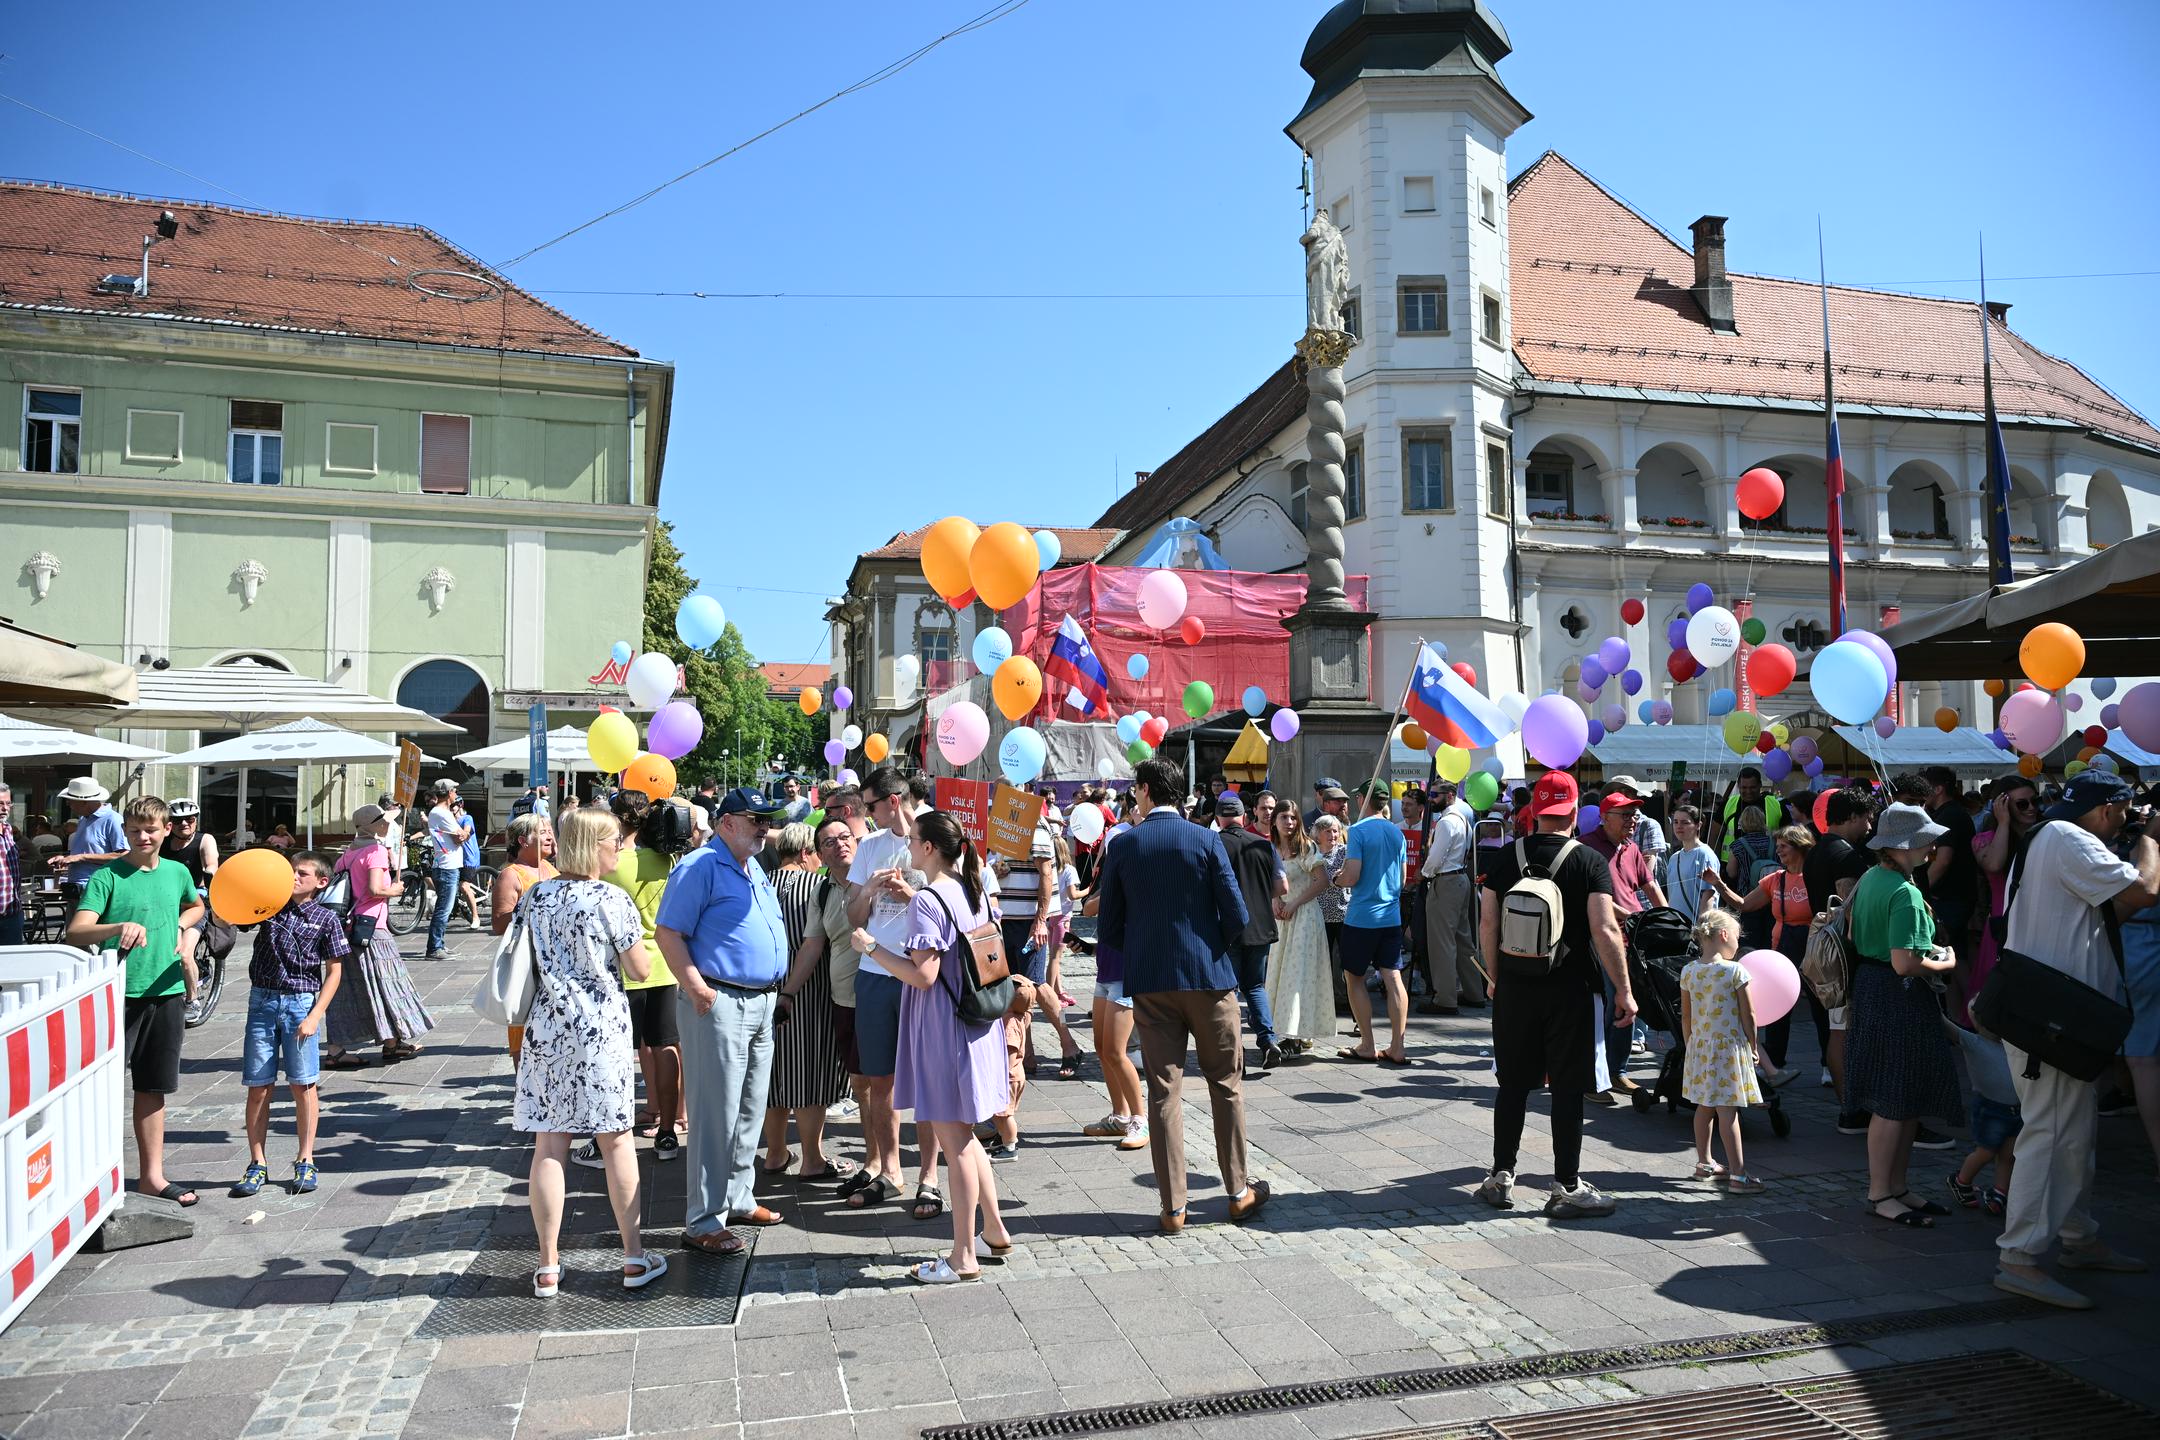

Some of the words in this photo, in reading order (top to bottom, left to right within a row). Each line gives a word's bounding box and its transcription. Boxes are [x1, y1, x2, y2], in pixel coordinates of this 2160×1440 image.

[950, 796, 965, 807] VSAK
[967, 798, 975, 809] JE
[1008, 797, 1027, 810] SPLAV
[1009, 809, 1020, 822] NI
[996, 829, 1021, 844] OSKRBA!
